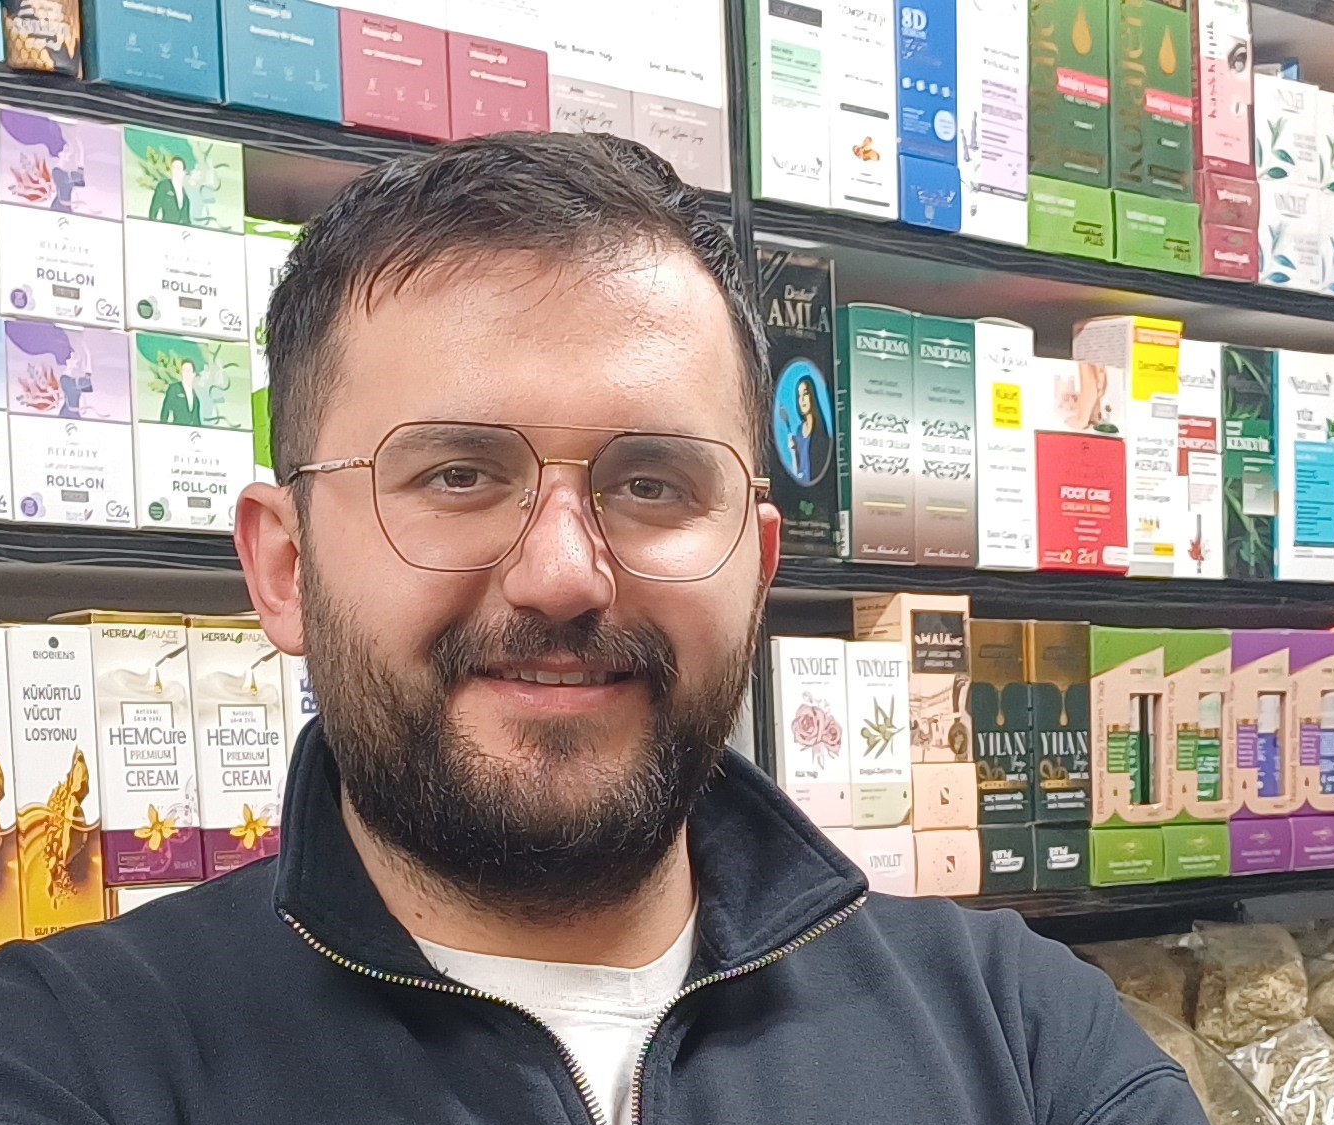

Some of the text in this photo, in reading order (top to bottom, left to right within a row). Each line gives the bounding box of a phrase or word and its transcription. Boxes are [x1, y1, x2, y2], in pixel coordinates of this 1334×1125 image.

[901, 8, 927, 31] 8D
[36, 267, 95, 287] ROLL-ON
[161, 279, 217, 297] ROLL-ON
[104, 303, 120, 318] 24
[767, 298, 831, 334] AMLA
[46, 474, 104, 490] ROLL-ON
[172, 480, 228, 495] ROLL-ON
[114, 504, 130, 518] 24
[102, 628, 139, 639] HERBAL
[201, 632, 236, 642] HERBAL
[22, 684, 82, 702] KÜKÜRTLÜ
[24, 705, 63, 721] VÜCUT
[25, 728, 78, 742] LOSYONU
[109, 727, 187, 746] HEMCure
[207, 728, 280, 746] HEMCure
[130, 749, 172, 761] PREMIUM
[226, 751, 265, 762] PREMIUM
[125, 769, 180, 787] CREAM
[222, 770, 272, 787] CREAM
